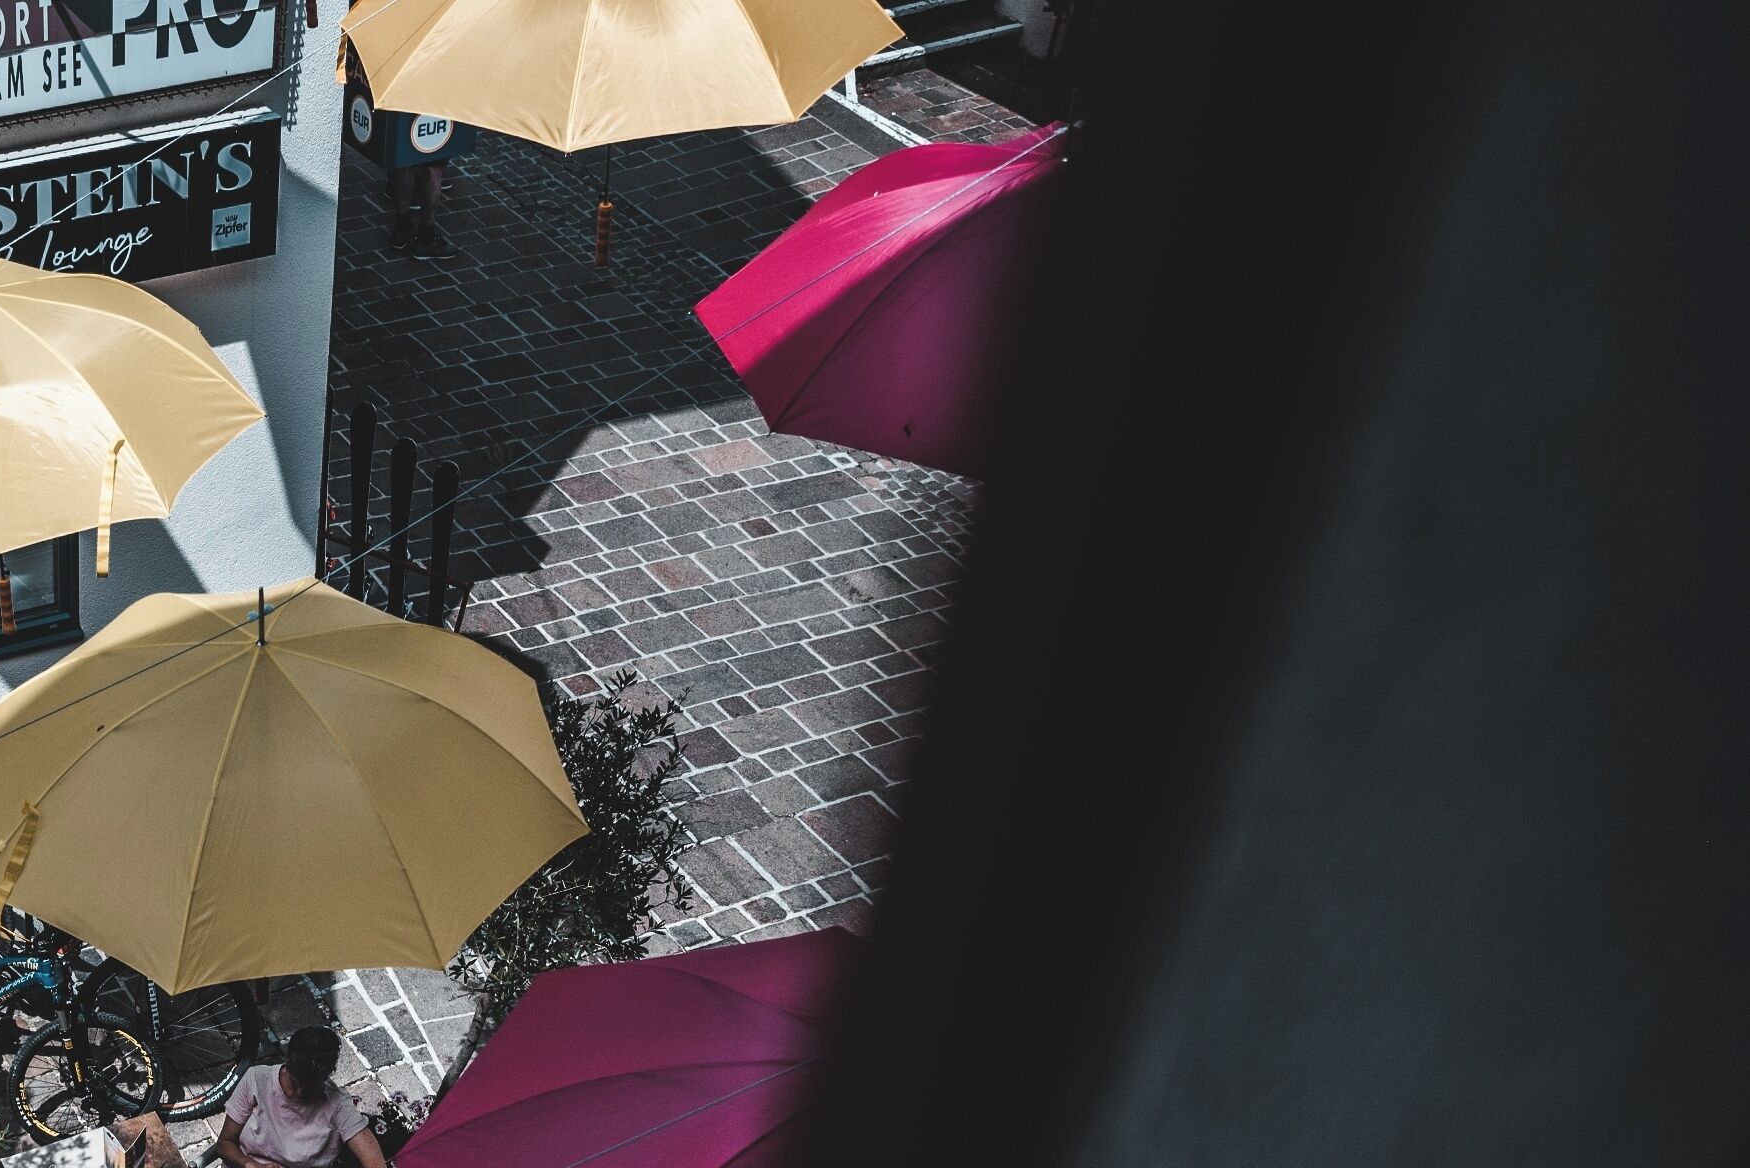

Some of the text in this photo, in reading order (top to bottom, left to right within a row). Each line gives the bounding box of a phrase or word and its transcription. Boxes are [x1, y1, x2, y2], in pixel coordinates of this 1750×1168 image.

[42, 44, 83, 93] SEE
[353, 109, 370, 132] EUR
[418, 120, 447, 137] EUR
[215, 221, 249, 238] Zipfer
